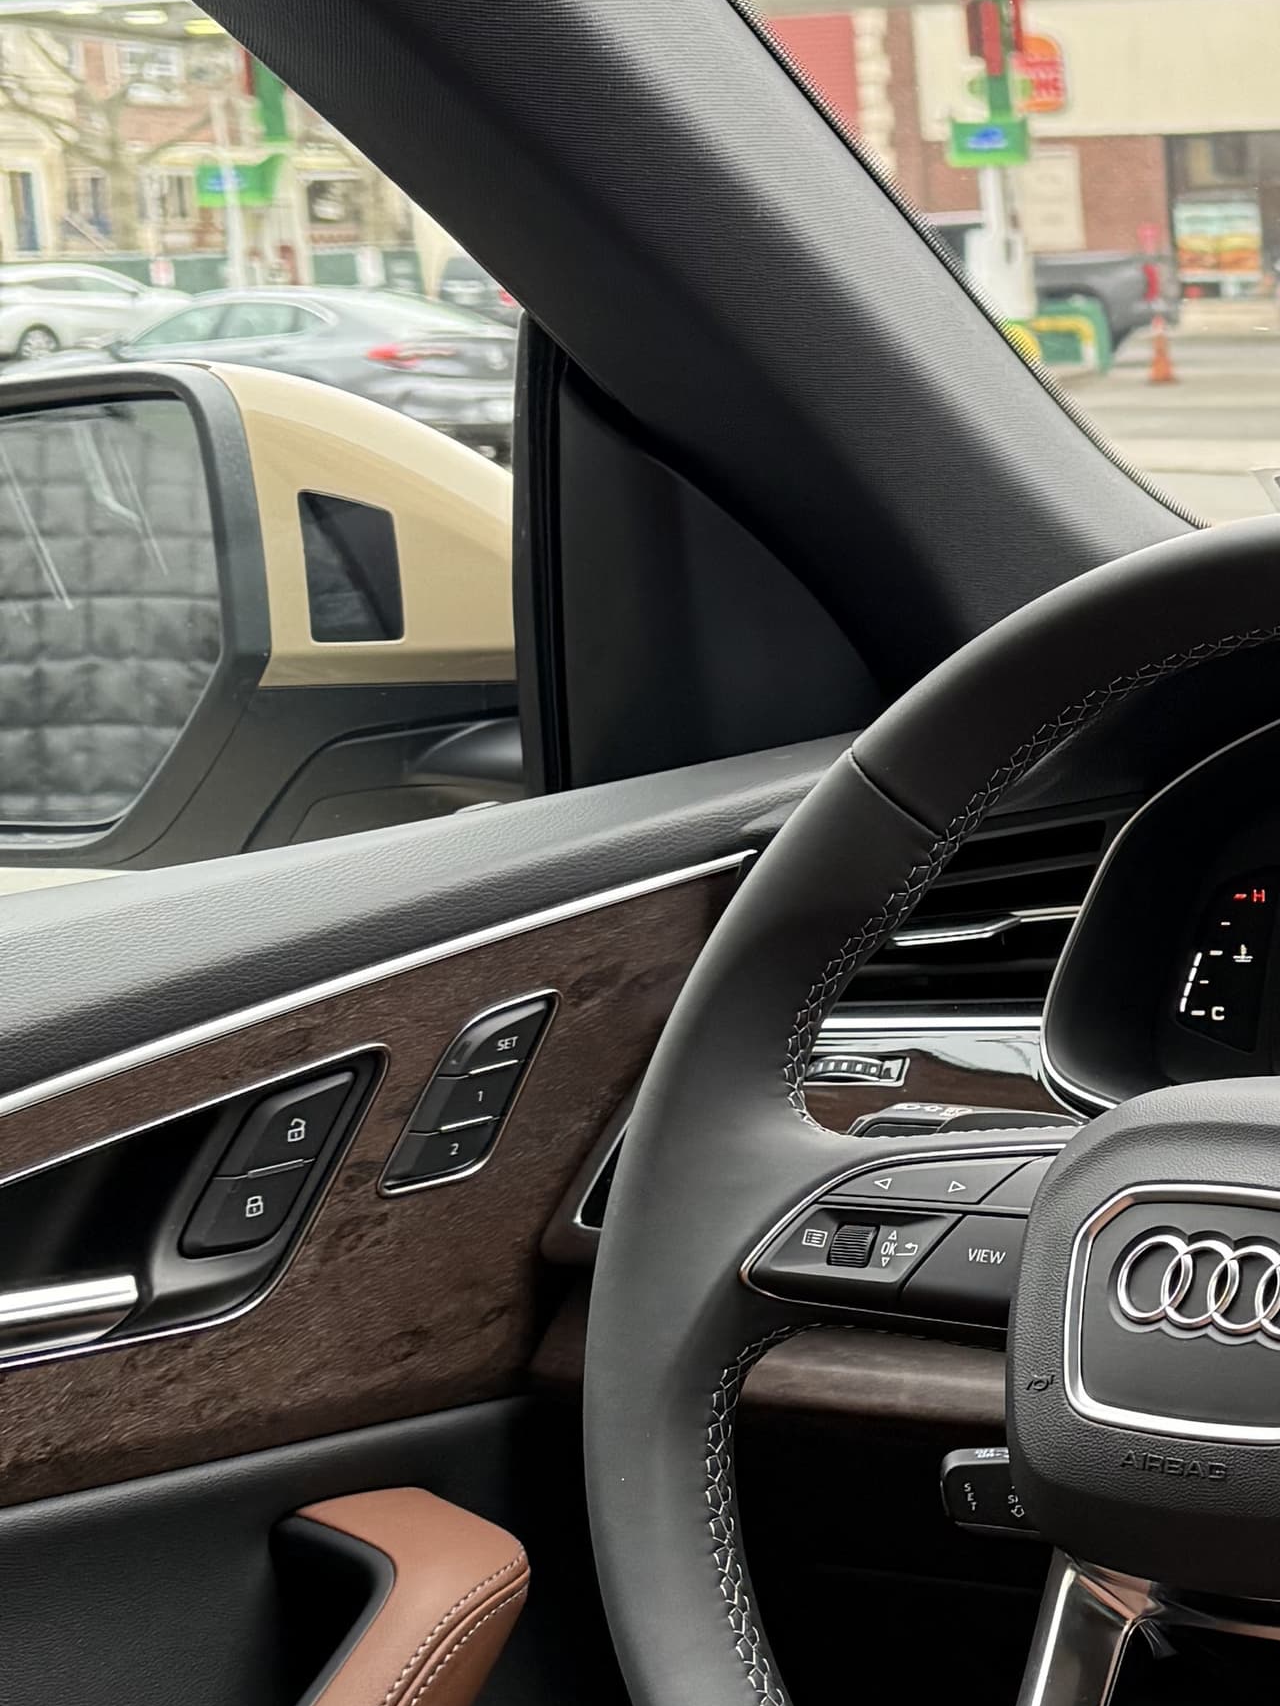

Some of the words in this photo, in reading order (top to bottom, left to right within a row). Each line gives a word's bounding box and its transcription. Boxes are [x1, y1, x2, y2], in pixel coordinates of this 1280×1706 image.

[1253, 890, 1265, 902] H
[1212, 1007, 1224, 1020] C
[497, 1037, 517, 1050] SET
[477, 1090, 483, 1102] 1
[451, 1143, 458, 1155] 2
[881, 1242, 897, 1255] OK
[968, 1248, 1006, 1264] VIEW
[1121, 1450, 1226, 1479] AIRBAG
